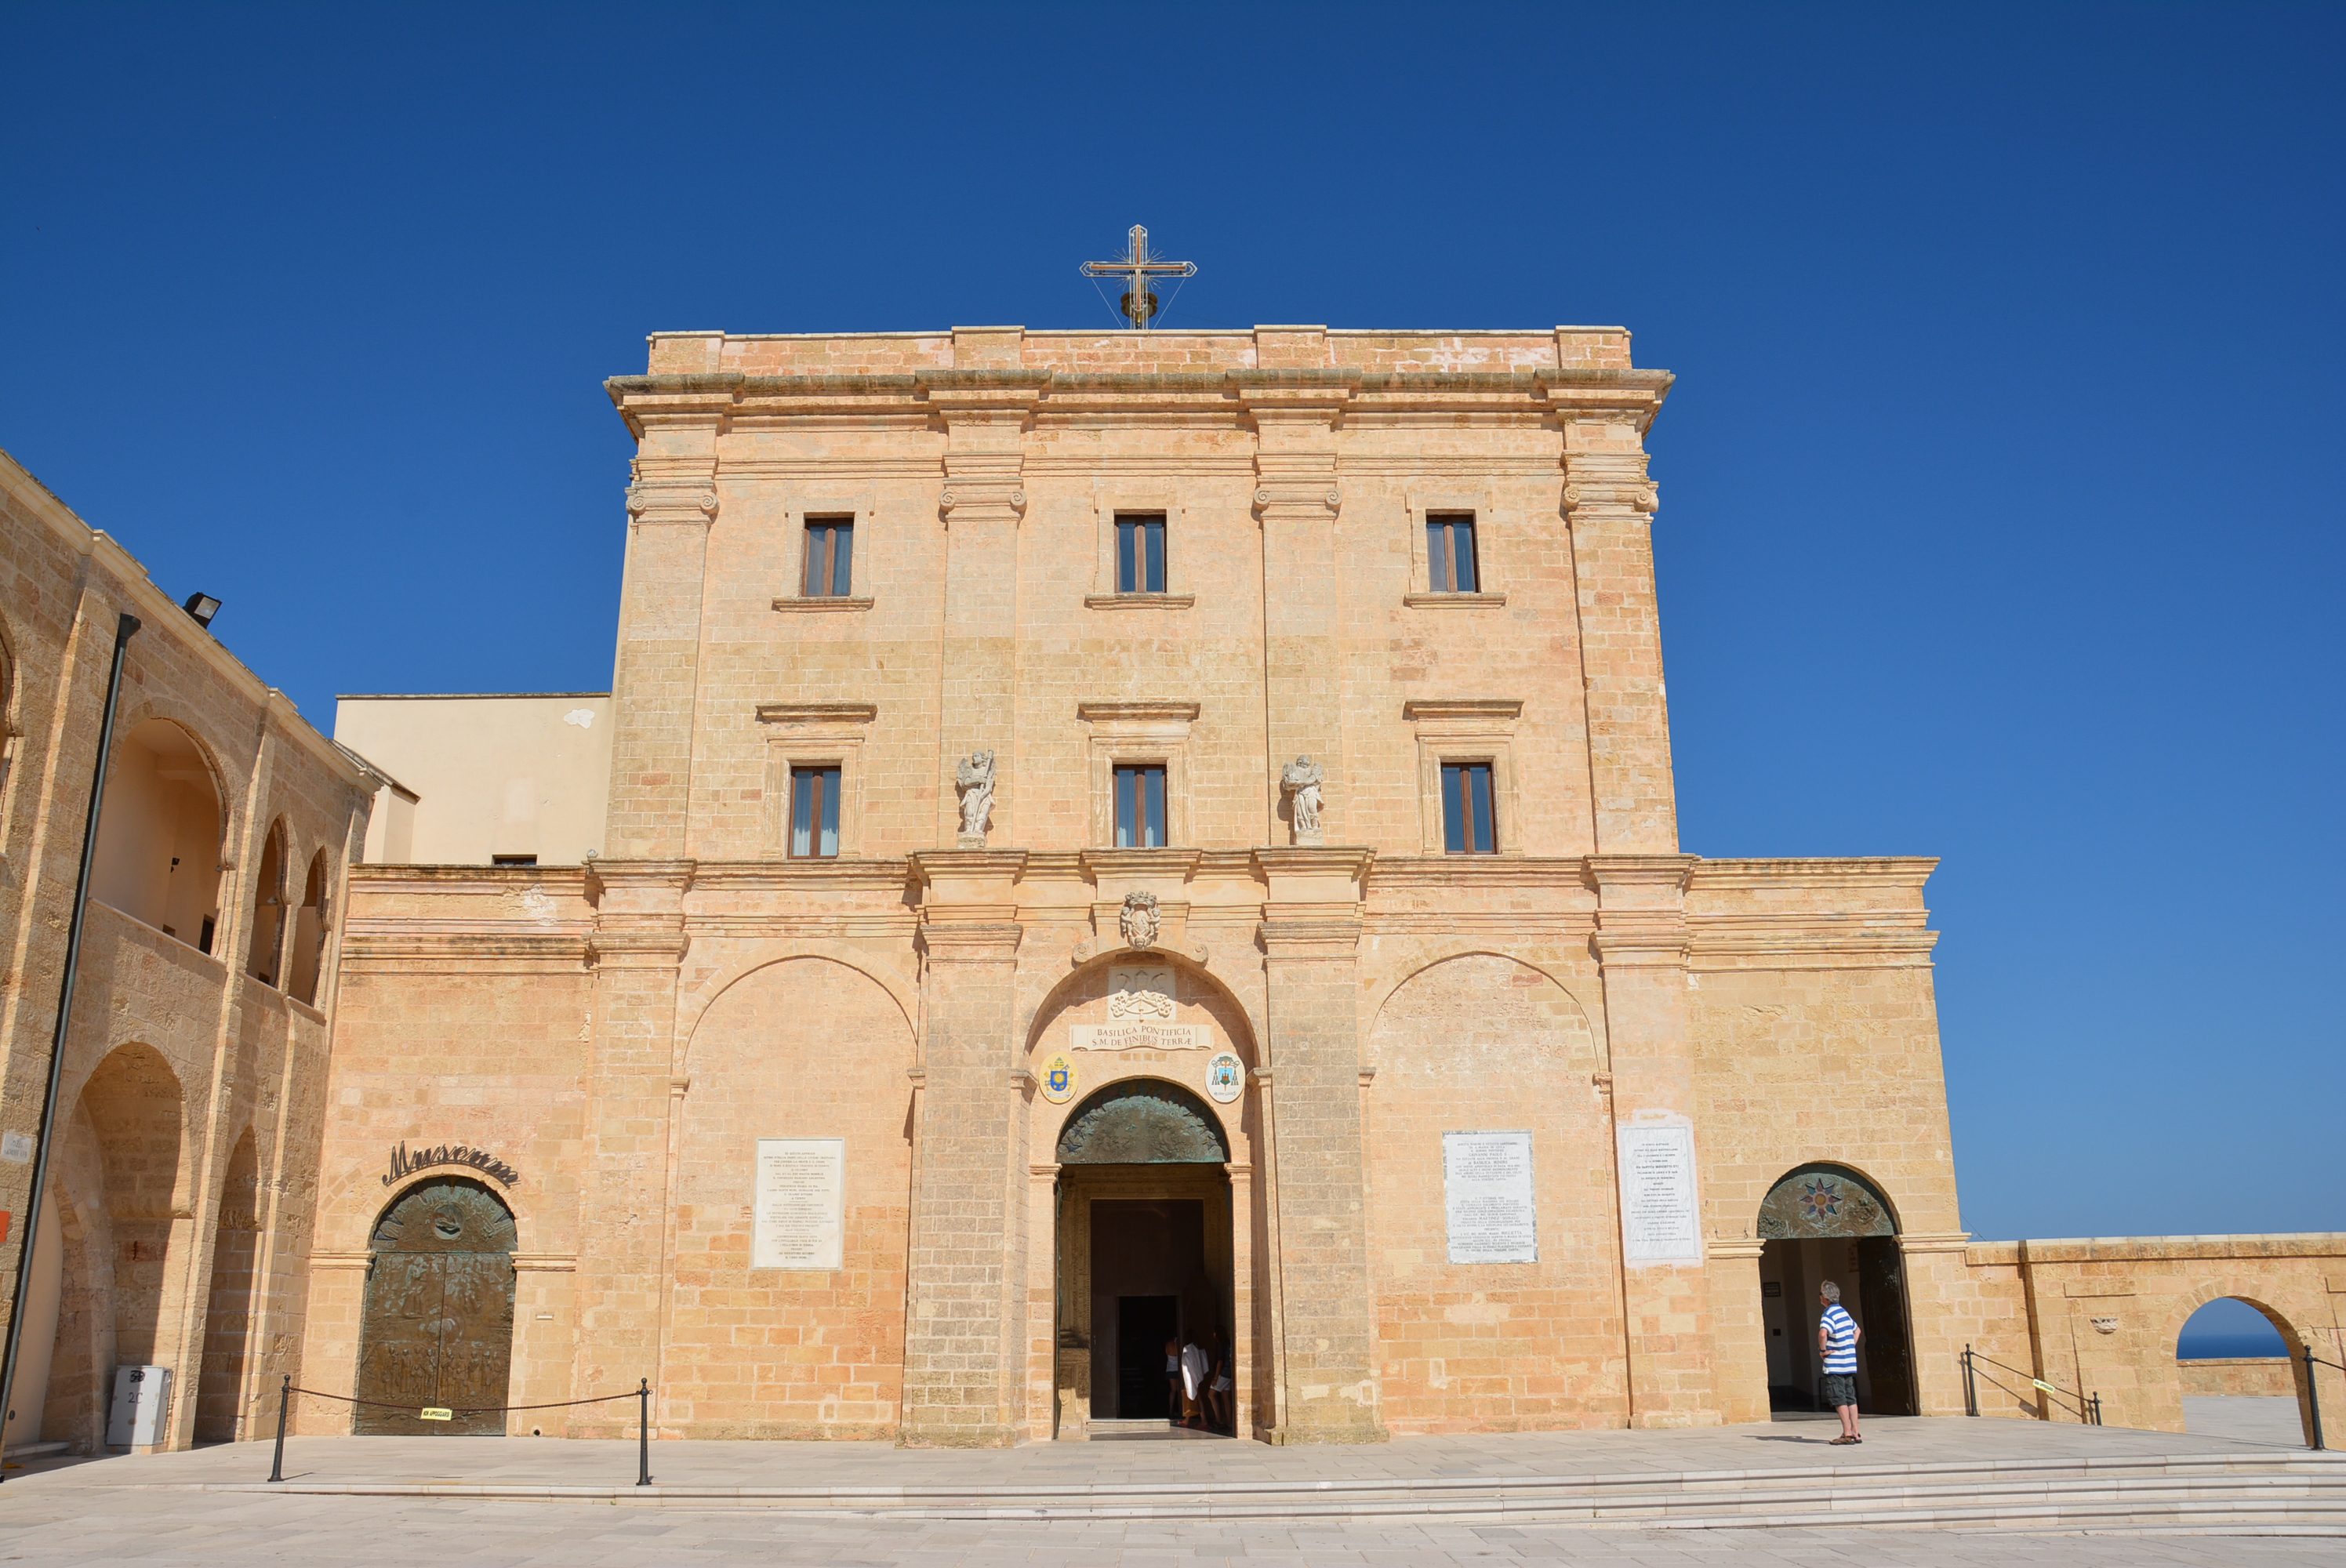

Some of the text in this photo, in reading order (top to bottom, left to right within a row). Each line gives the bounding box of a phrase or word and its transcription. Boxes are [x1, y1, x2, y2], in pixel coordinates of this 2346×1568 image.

[1097, 1025, 1191, 1036] BASILICA PONTIFICIA
[1124, 1035, 1158, 1045] FINIBUS
[382, 1140, 521, 1189] Museum
[128, 1392, 143, 1404] 2C
